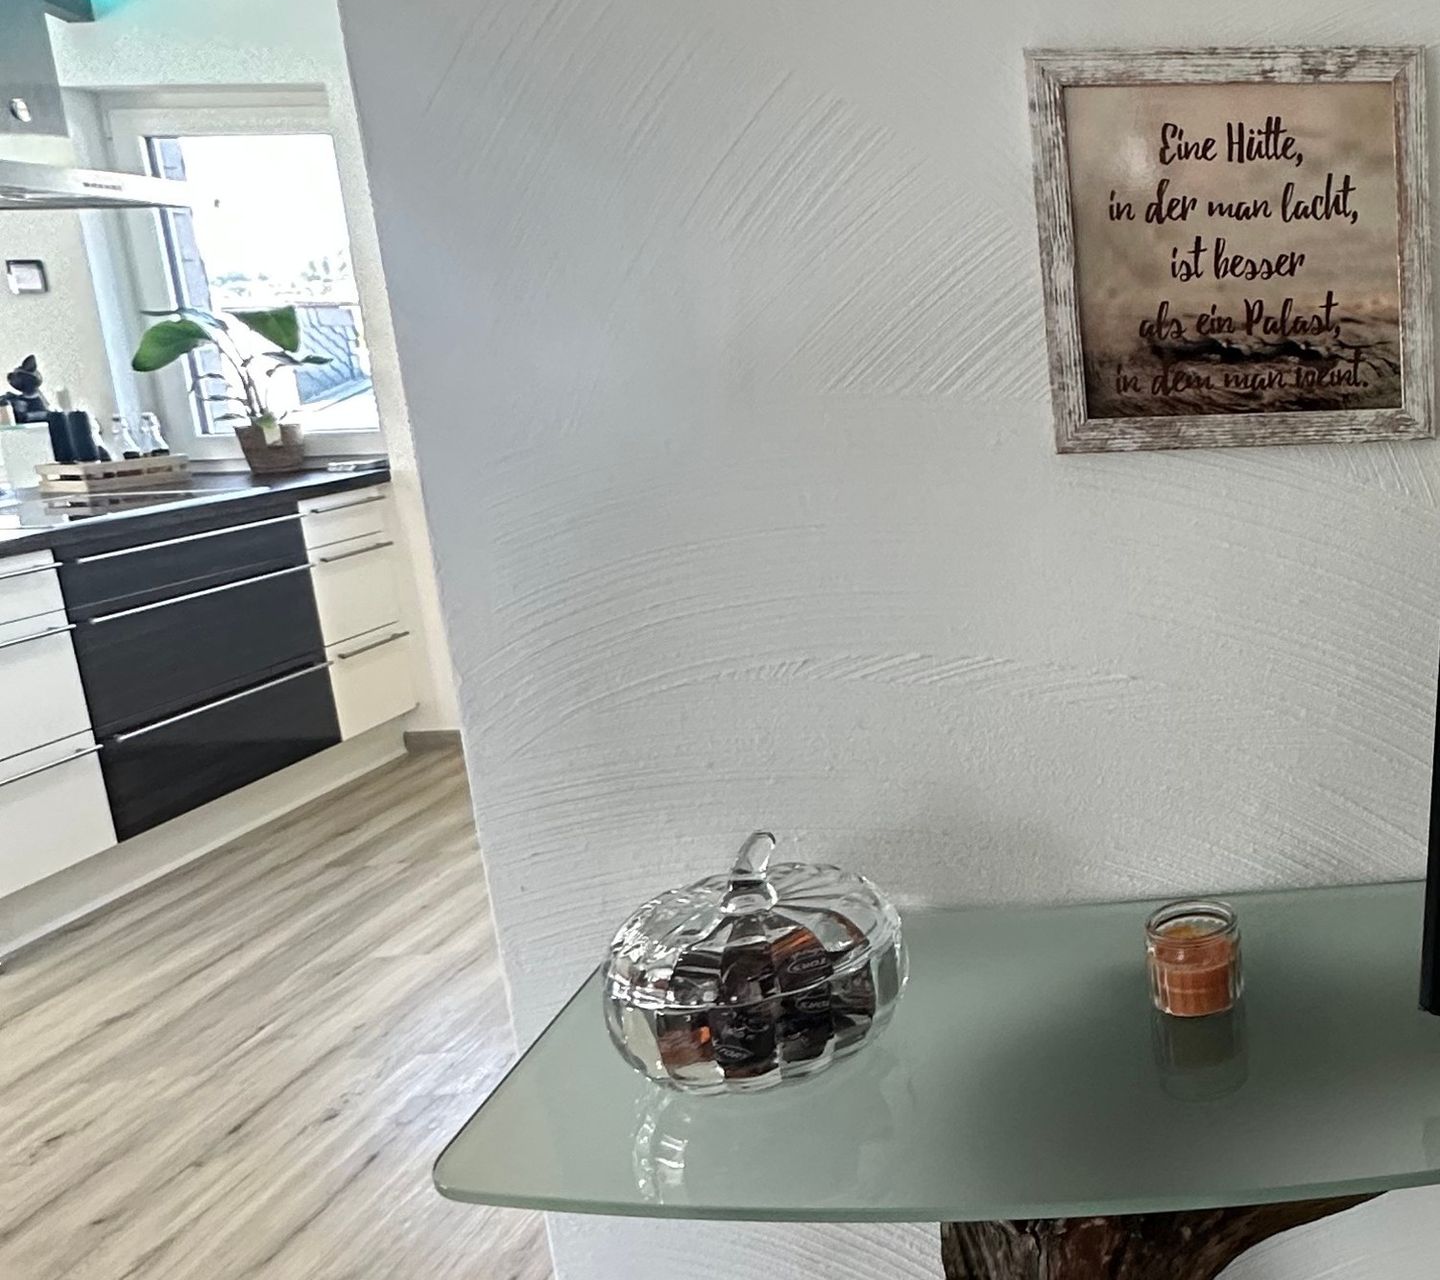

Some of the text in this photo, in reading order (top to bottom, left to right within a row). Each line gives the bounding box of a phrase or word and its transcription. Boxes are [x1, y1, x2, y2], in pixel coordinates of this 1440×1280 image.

[1159, 116, 1304, 167] Eine Hütte,
[1107, 173, 1359, 225] in der man lacht,
[1170, 235, 1306, 282] ist besser
[1138, 290, 1342, 339] als ein Palast,
[1115, 345, 1369, 396] in dem man weint.
